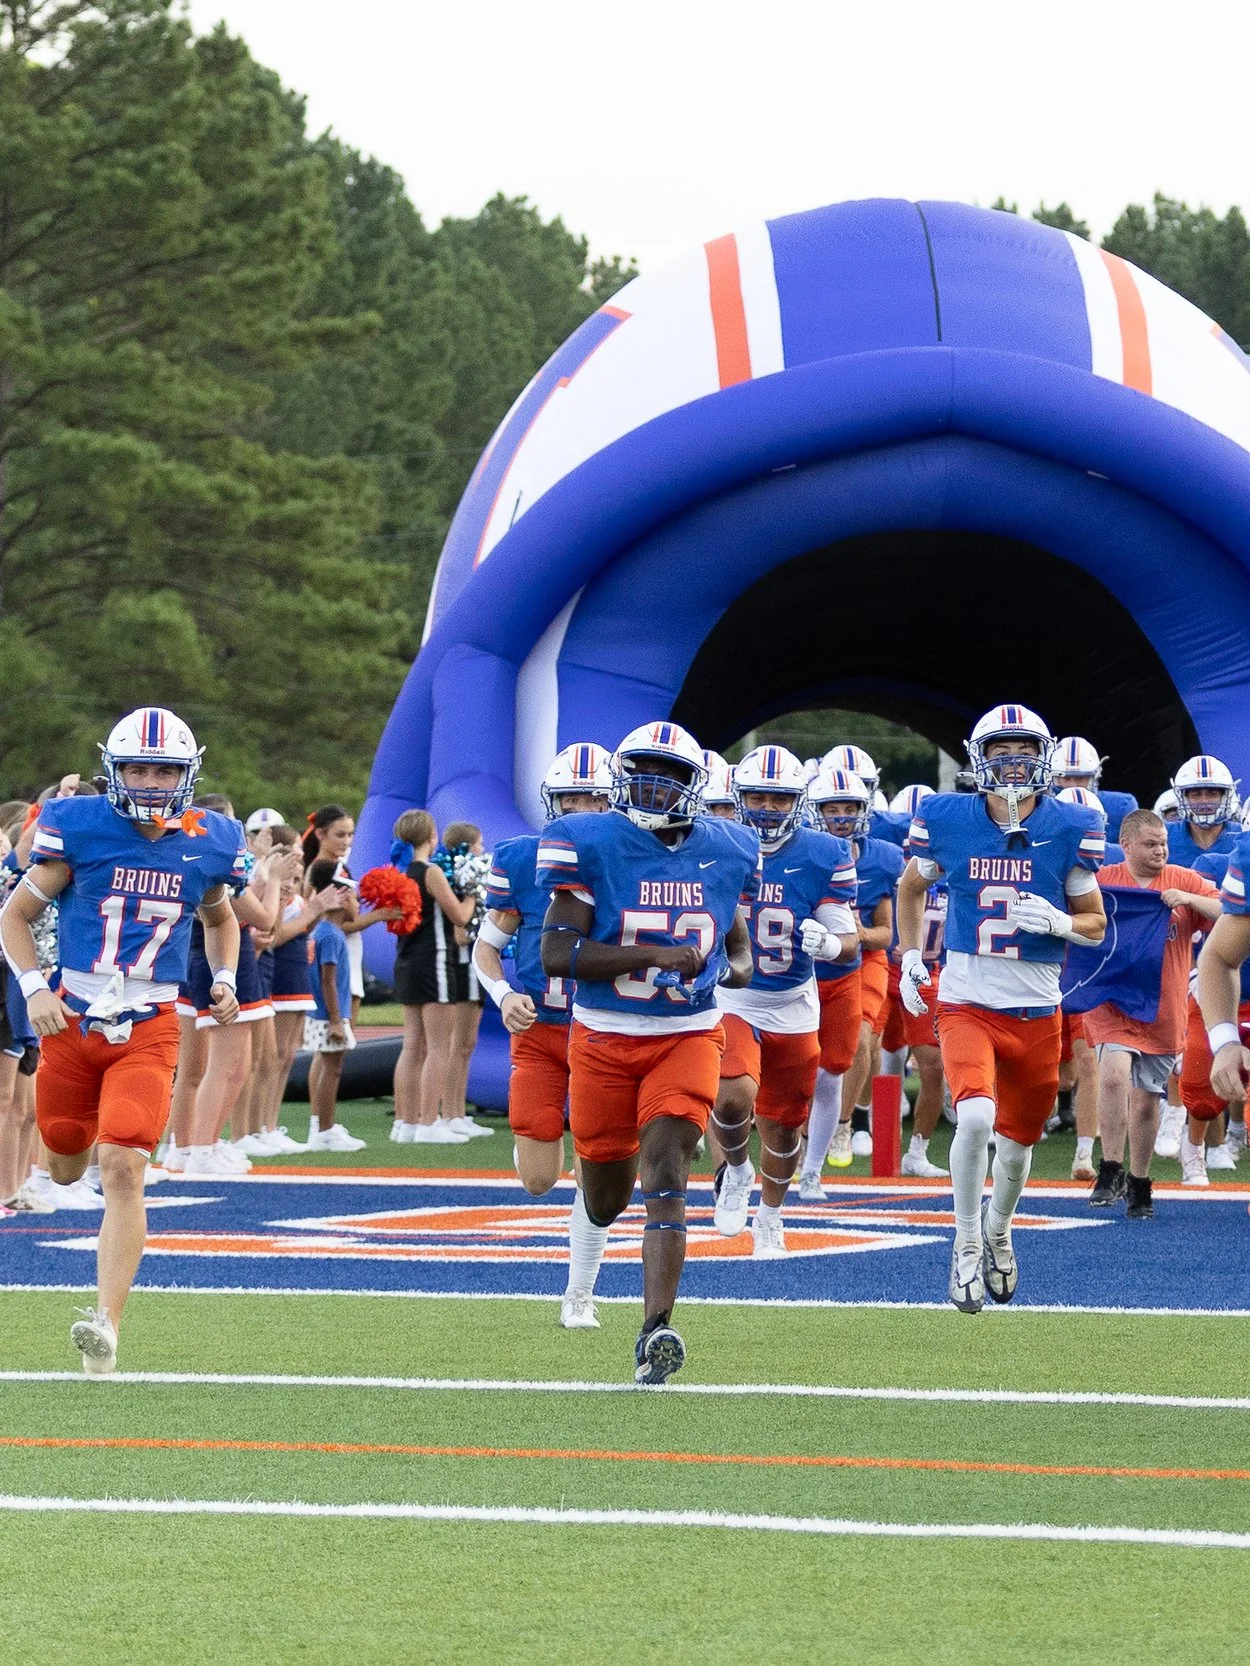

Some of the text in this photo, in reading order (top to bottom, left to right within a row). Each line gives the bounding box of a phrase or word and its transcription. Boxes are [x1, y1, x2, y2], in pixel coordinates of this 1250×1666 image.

[110, 866, 183, 898] BRUINS
[968, 857, 1033, 882] BRUINS
[638, 880, 704, 907] BRUINS
[91, 895, 184, 982] 17
[977, 885, 1021, 960] 2
